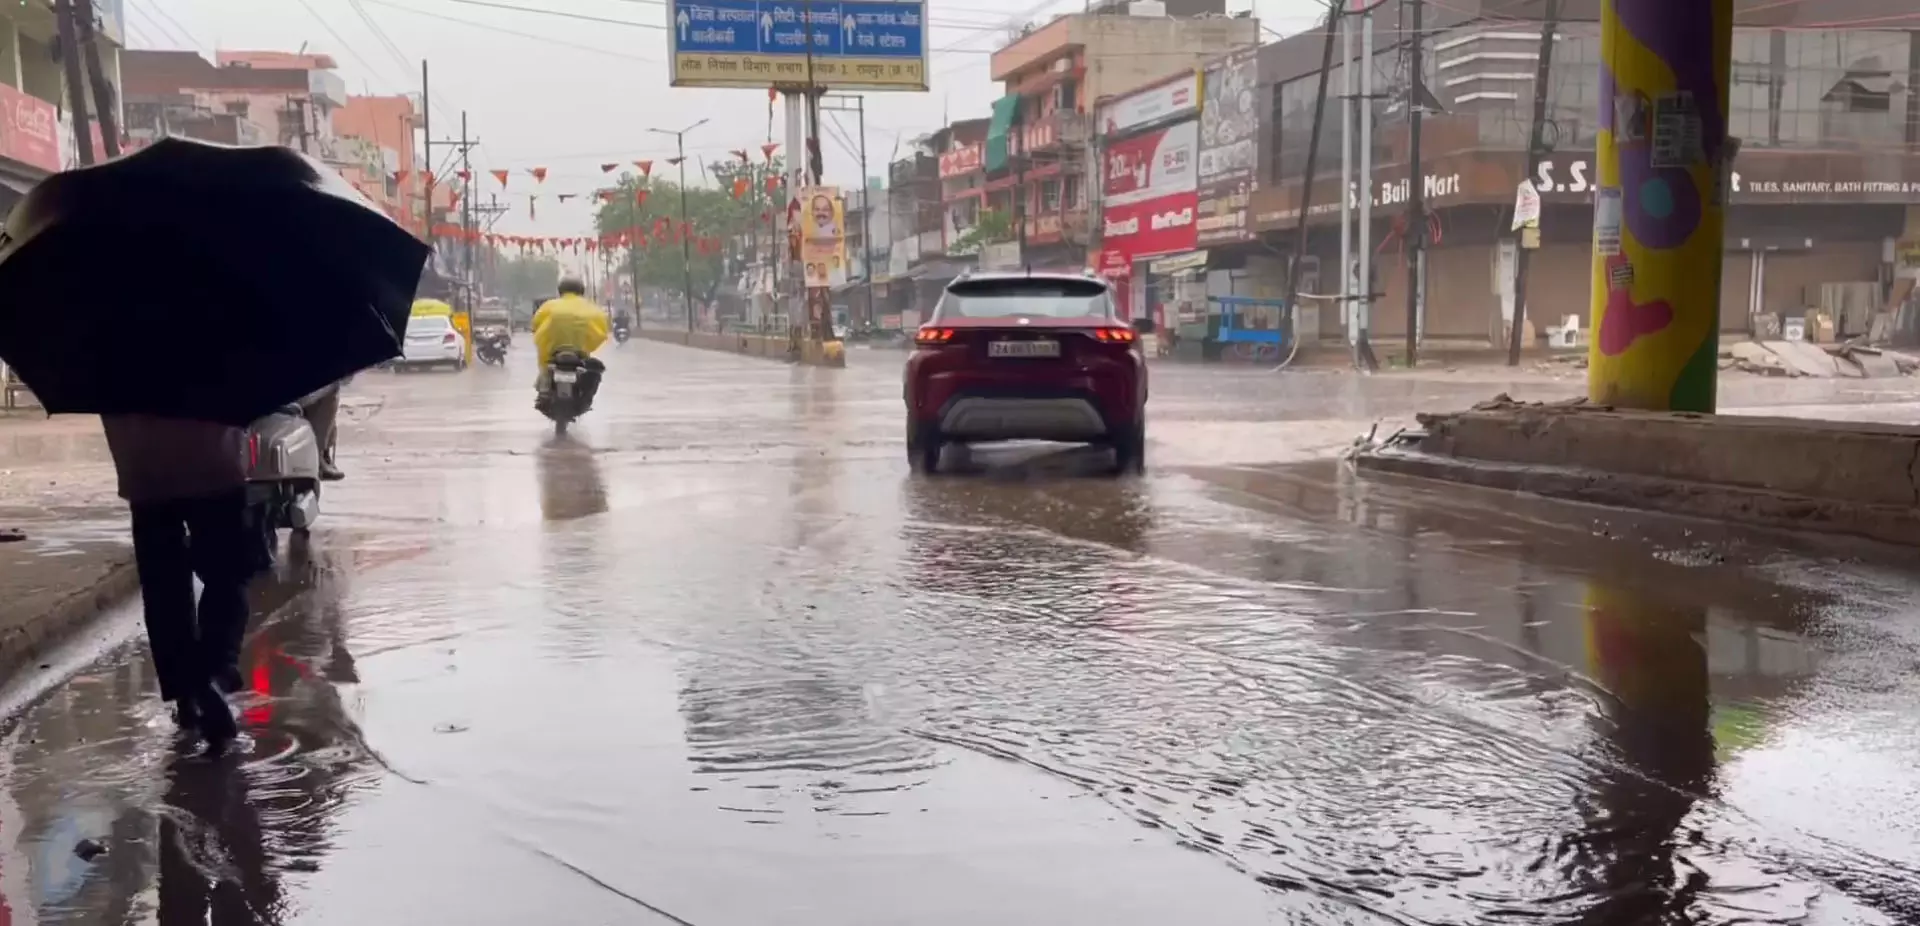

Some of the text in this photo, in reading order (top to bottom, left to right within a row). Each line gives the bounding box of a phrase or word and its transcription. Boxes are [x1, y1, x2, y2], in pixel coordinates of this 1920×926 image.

[1424, 172, 1460, 198] Mart
[1536, 160, 1597, 193] S.S.
[1834, 182, 1861, 193] BATH
[1863, 182, 1900, 193] FITTING
